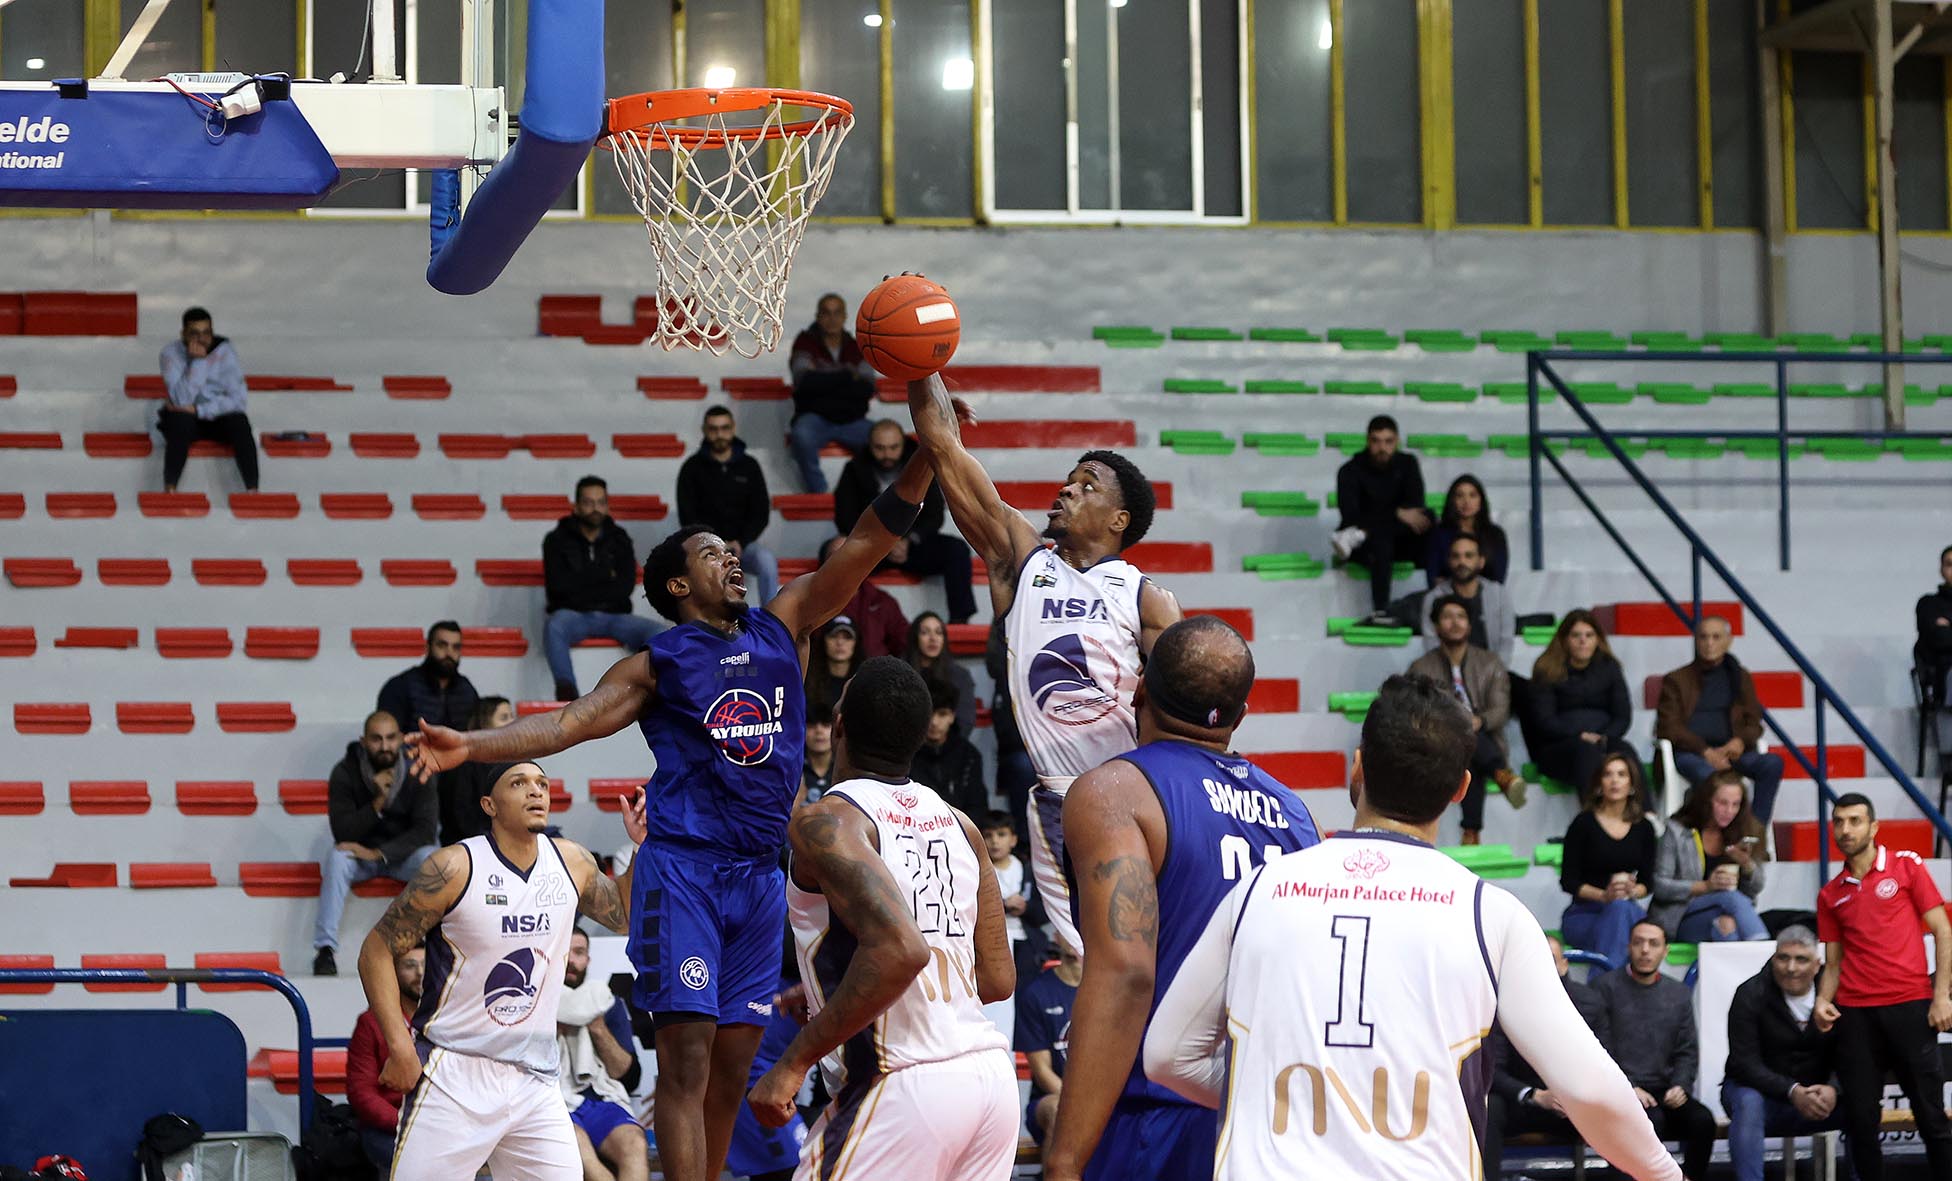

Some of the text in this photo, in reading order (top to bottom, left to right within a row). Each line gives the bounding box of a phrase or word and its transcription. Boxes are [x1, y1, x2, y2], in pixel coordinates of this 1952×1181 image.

[1041, 597, 1108, 621] NSA
[773, 686, 784, 718] 5
[533, 871, 568, 908] 22
[1272, 881, 1456, 906] Al Murjan Palace Hotel
[501, 912, 550, 933] NSA
[1325, 915, 1374, 1049] 1
